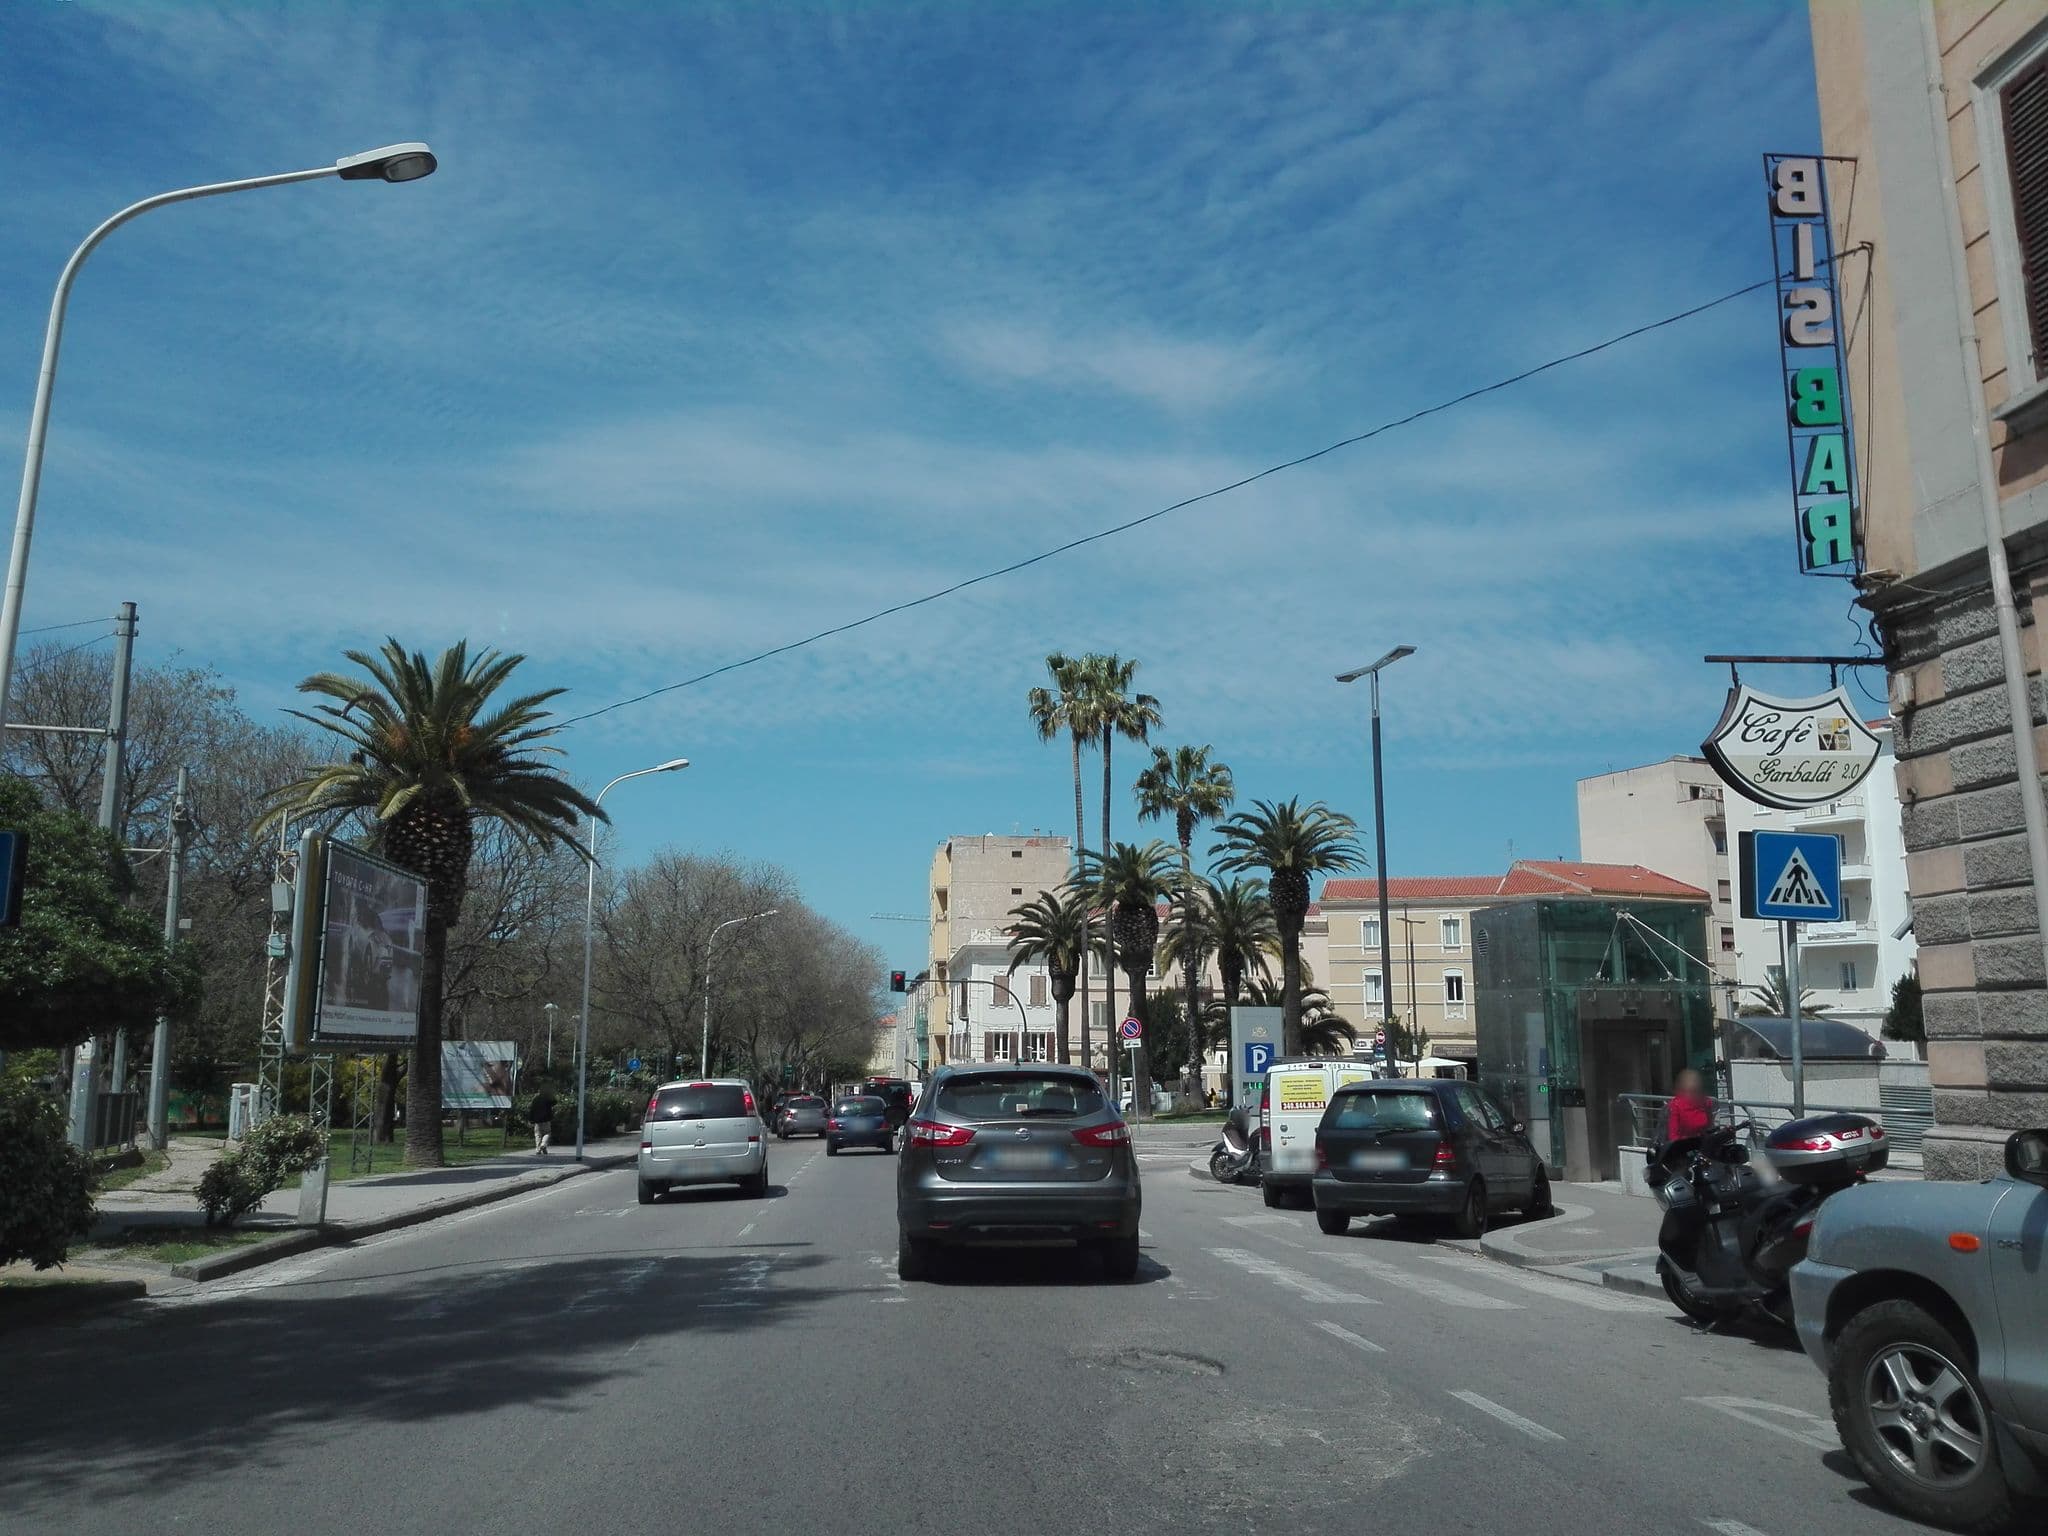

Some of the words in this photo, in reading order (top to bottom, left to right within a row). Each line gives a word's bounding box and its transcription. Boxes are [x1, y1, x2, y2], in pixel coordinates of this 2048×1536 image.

[1754, 759, 1837, 783] Garibaldi
[1842, 763, 1860, 779] 2.0
[1253, 1049, 1267, 1072] P
